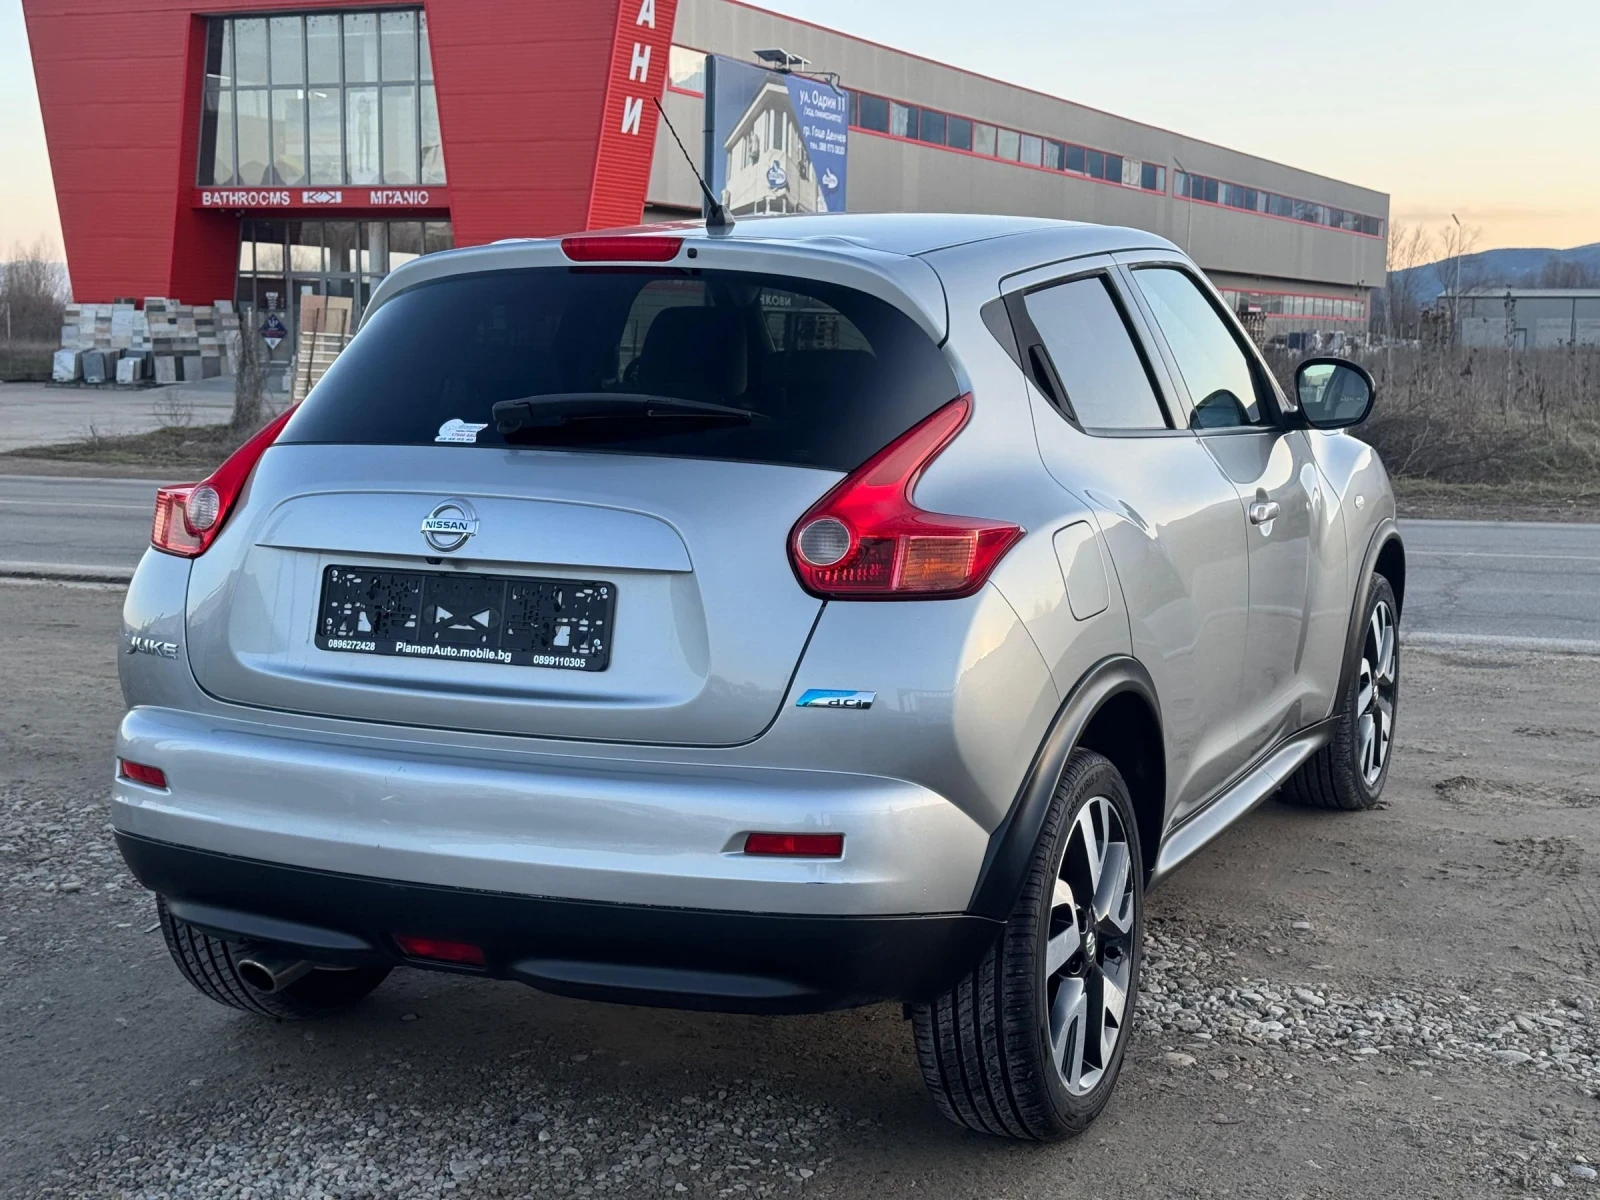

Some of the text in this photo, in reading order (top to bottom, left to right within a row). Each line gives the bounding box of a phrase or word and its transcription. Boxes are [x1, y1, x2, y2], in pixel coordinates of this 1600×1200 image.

[812, 89, 837, 110] Одрин
[838, 96, 846, 112] 11
[812, 125, 825, 138] Гоце
[425, 520, 468, 531] NISSAN
[125, 636, 179, 660] JUKE
[328, 638, 376, 652] 0896272428
[395, 641, 513, 663] PlamenAuto.mobile.bg
[533, 654, 586, 668] 0899110305
[828, 698, 862, 707] dCi
